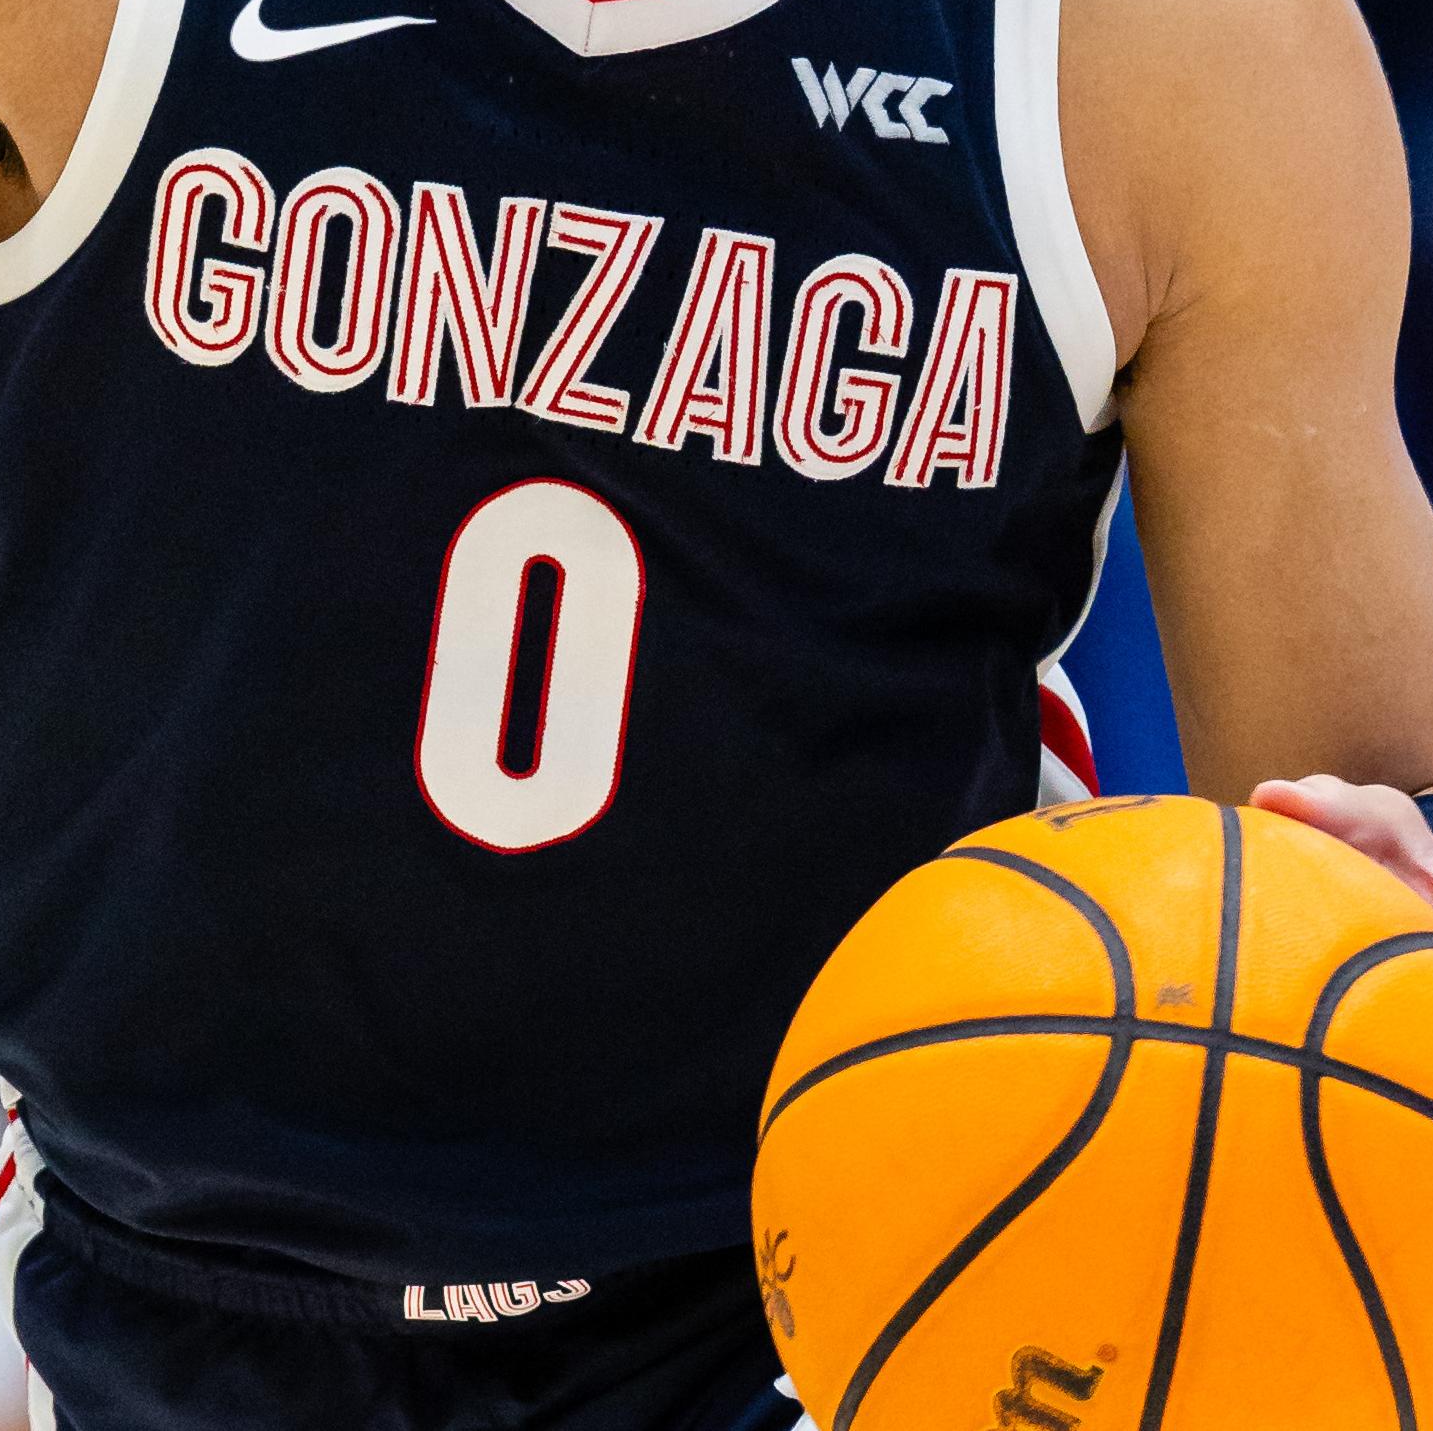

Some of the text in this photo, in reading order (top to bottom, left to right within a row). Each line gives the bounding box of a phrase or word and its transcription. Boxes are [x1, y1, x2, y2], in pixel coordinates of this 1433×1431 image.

[791, 57, 954, 145] WCC
[144, 147, 1019, 490] GONZAGA
[413, 478, 646, 855] 0
